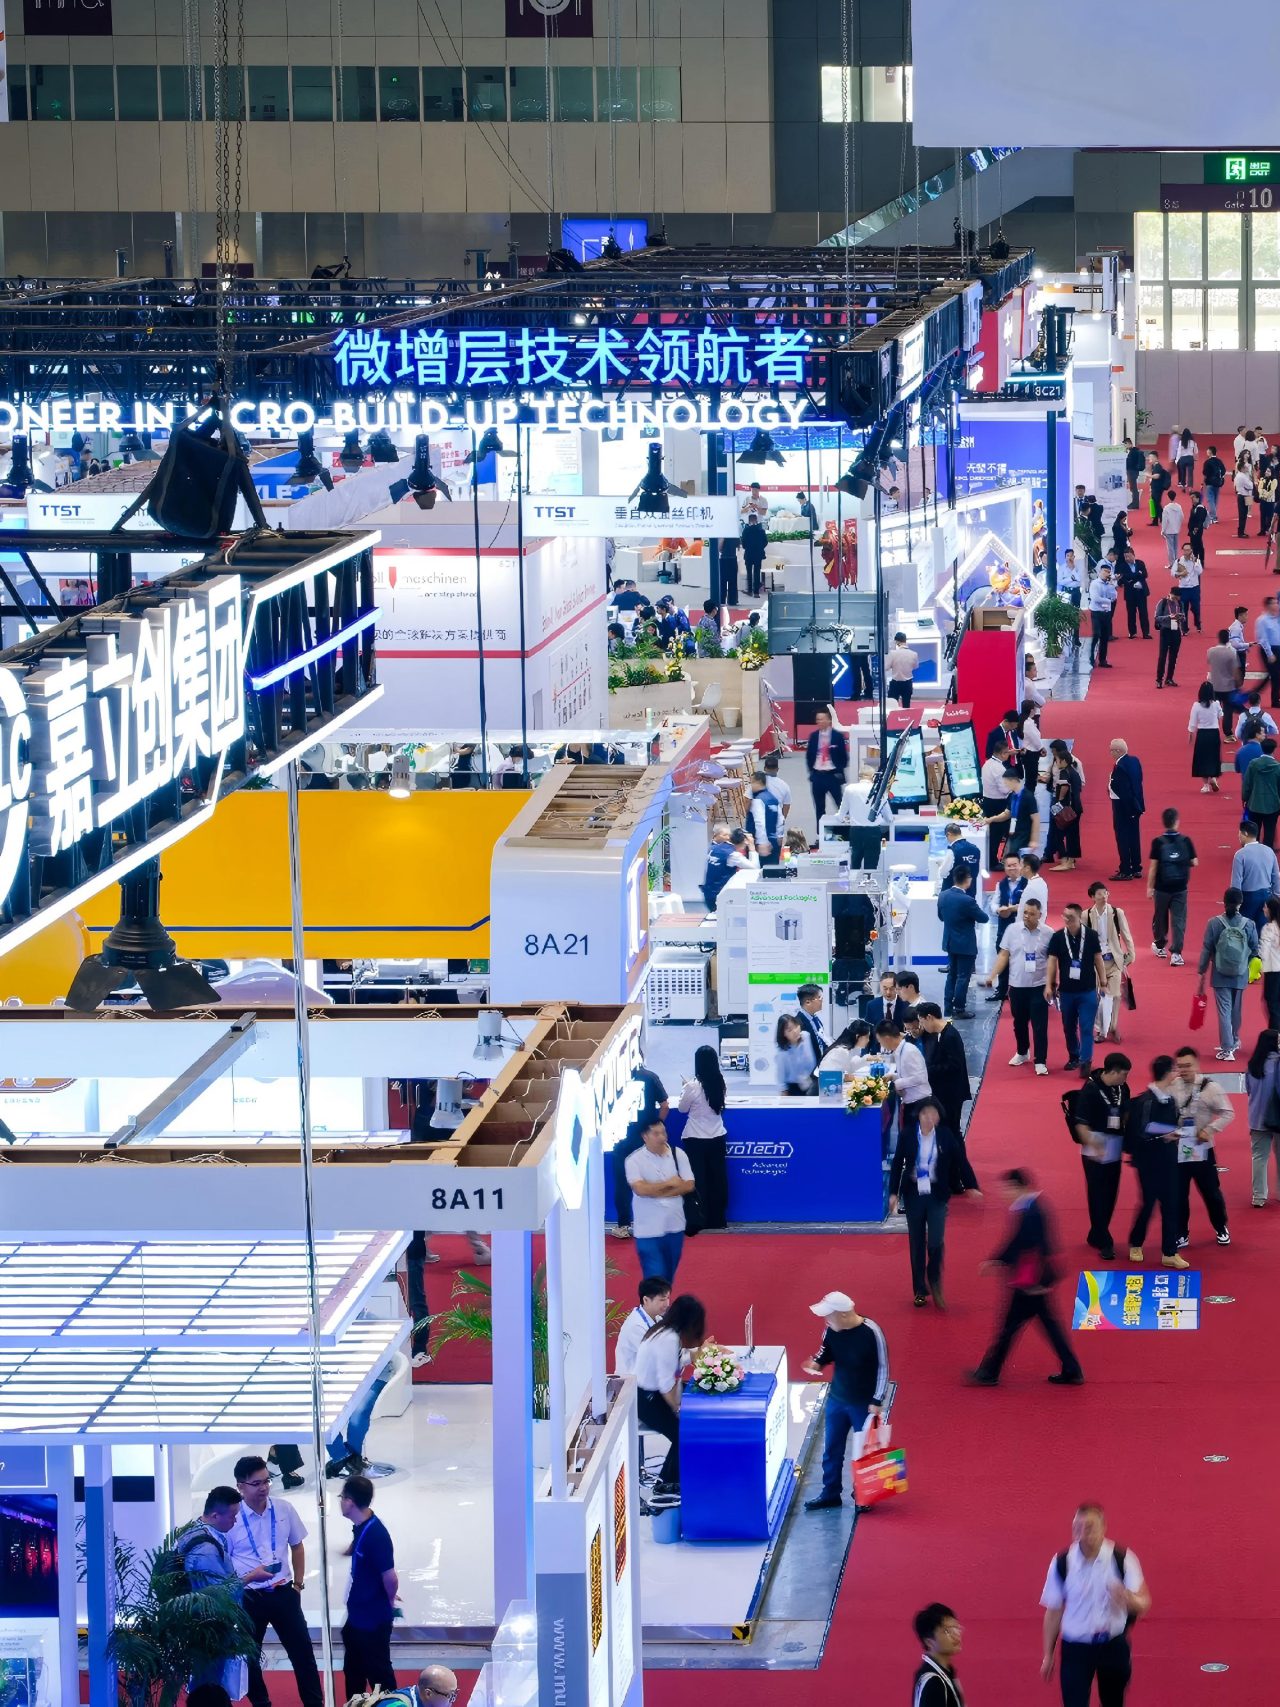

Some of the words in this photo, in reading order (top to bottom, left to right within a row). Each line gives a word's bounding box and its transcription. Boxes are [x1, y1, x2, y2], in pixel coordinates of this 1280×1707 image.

[1249, 188, 1273, 208] 10
[333, 327, 811, 386] 微增层技术领航者
[134, 400, 174, 433] IN
[187, 398, 519, 435] CRO-BUILD-UP
[527, 398, 811, 431] TECHNOLOGY
[39, 505, 82, 517] TTST
[534, 506, 576, 518] TTST
[45, 574, 246, 857] 嘉立创集团
[523, 934, 590, 957] 8A21
[431, 1188, 504, 1210] 8A11
